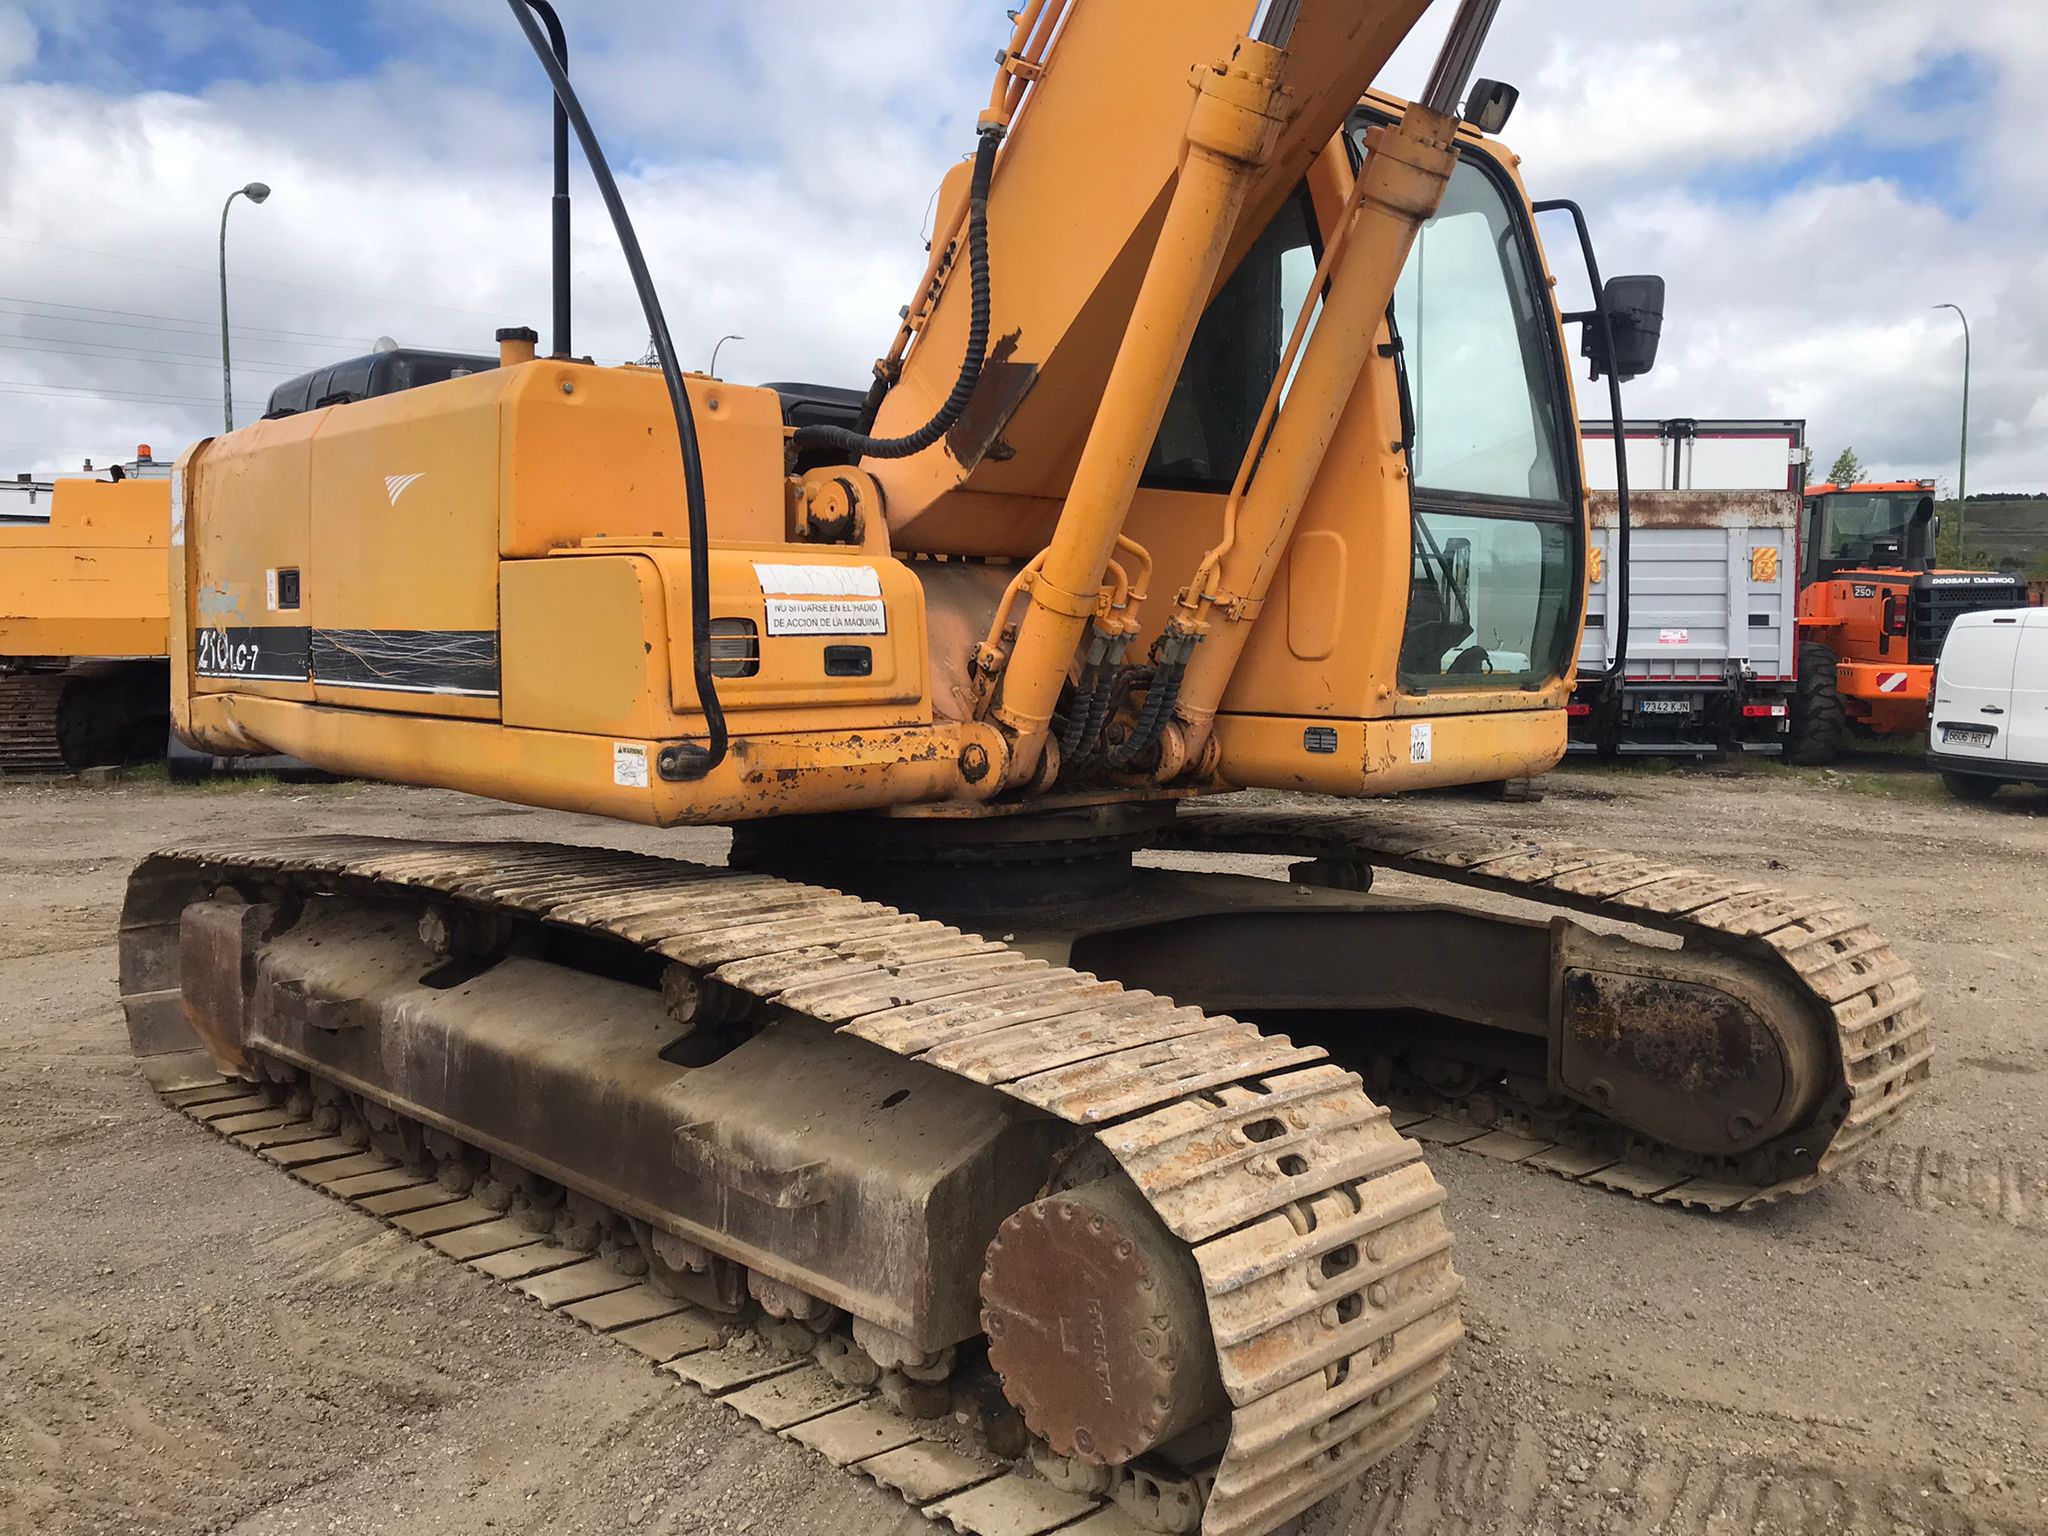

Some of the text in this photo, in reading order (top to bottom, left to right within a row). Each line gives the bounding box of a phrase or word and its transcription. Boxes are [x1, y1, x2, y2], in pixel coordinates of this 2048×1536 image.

[1932, 577, 1971, 585] DOOSAN
[774, 603, 877, 612] NO SITUARSE EN EL RADIO
[773, 618, 880, 627] DE ACCION DE LA MAQUINA
[1645, 702, 1689, 711] 7342 KJN
[1949, 730, 1987, 744] 6606 HRT
[1412, 741, 1425, 760] 102
